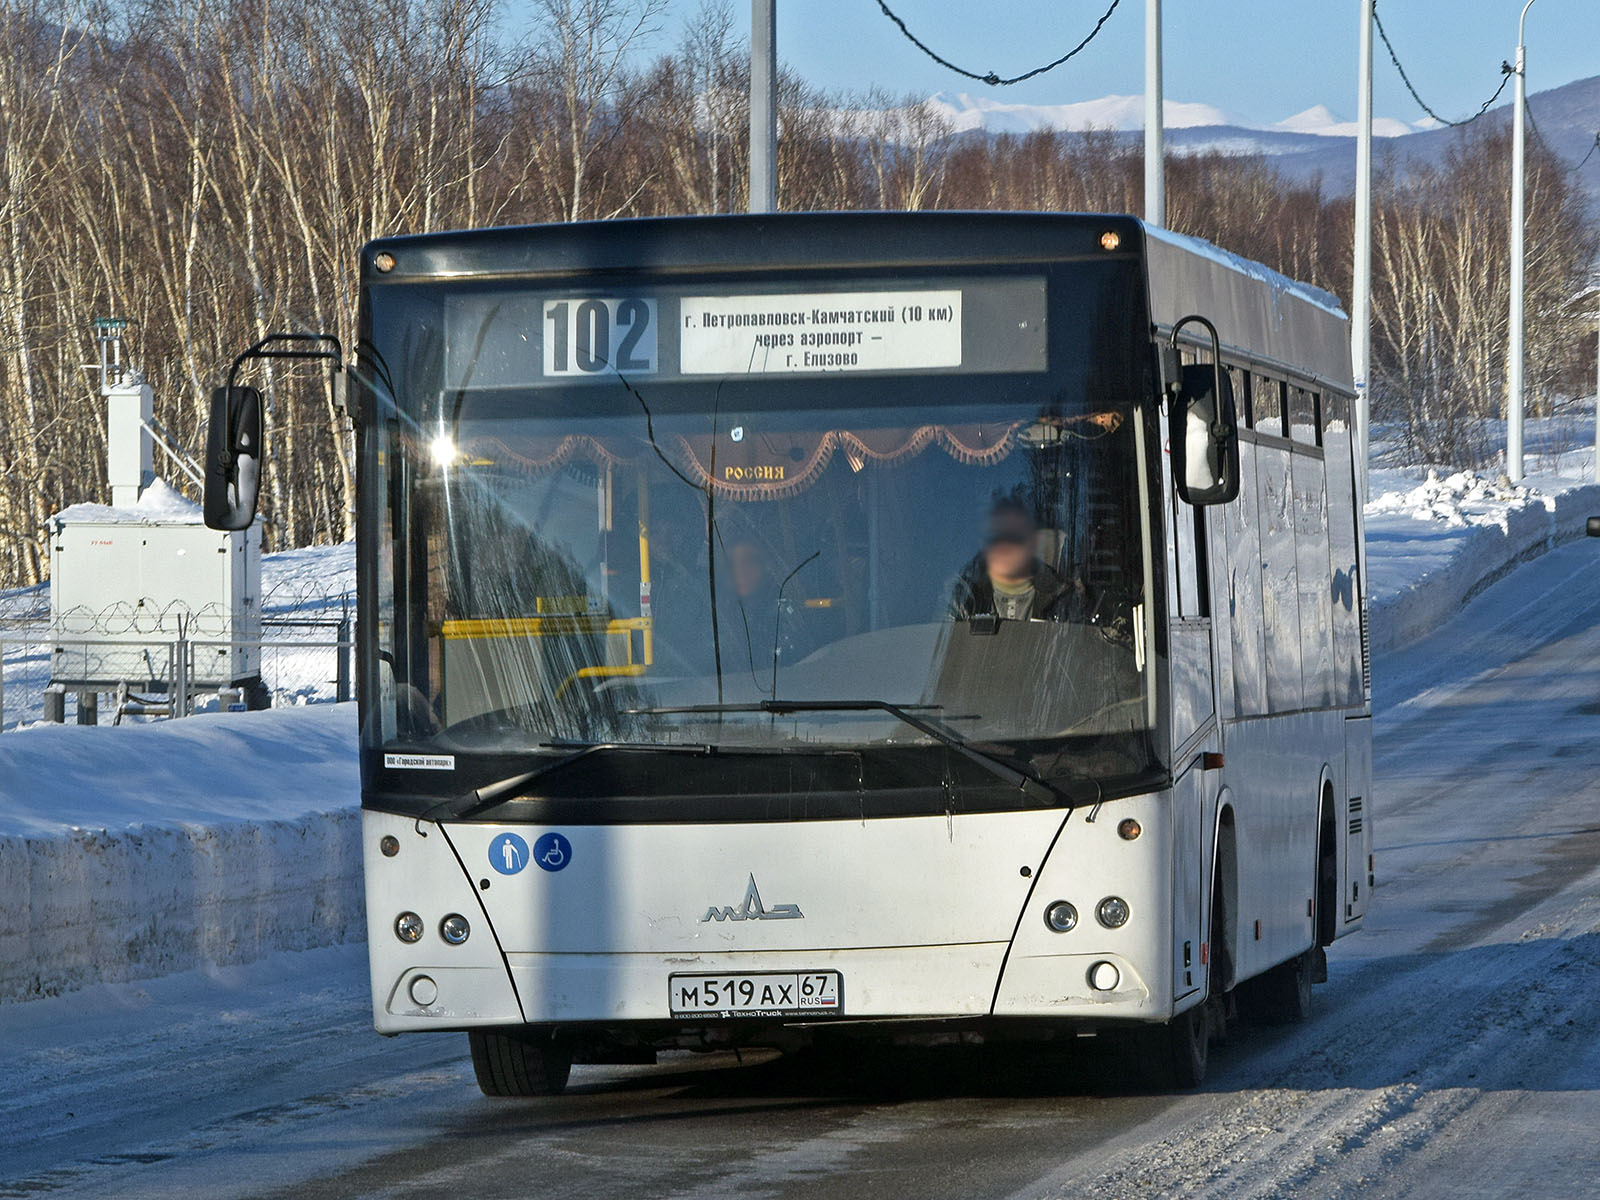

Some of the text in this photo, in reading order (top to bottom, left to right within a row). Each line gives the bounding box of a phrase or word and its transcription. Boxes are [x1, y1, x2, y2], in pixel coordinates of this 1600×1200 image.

[685, 305, 954, 329] г. Петропавловск-Камчатский (10 км)
[547, 299, 650, 372] 102
[756, 334, 794, 349] через
[800, 331, 863, 347] аэропорт
[787, 352, 858, 367] г. Елизово
[725, 465, 785, 480] РОССИЯ
[801, 976, 828, 997] 67
[800, 997, 820, 1006] RUS
